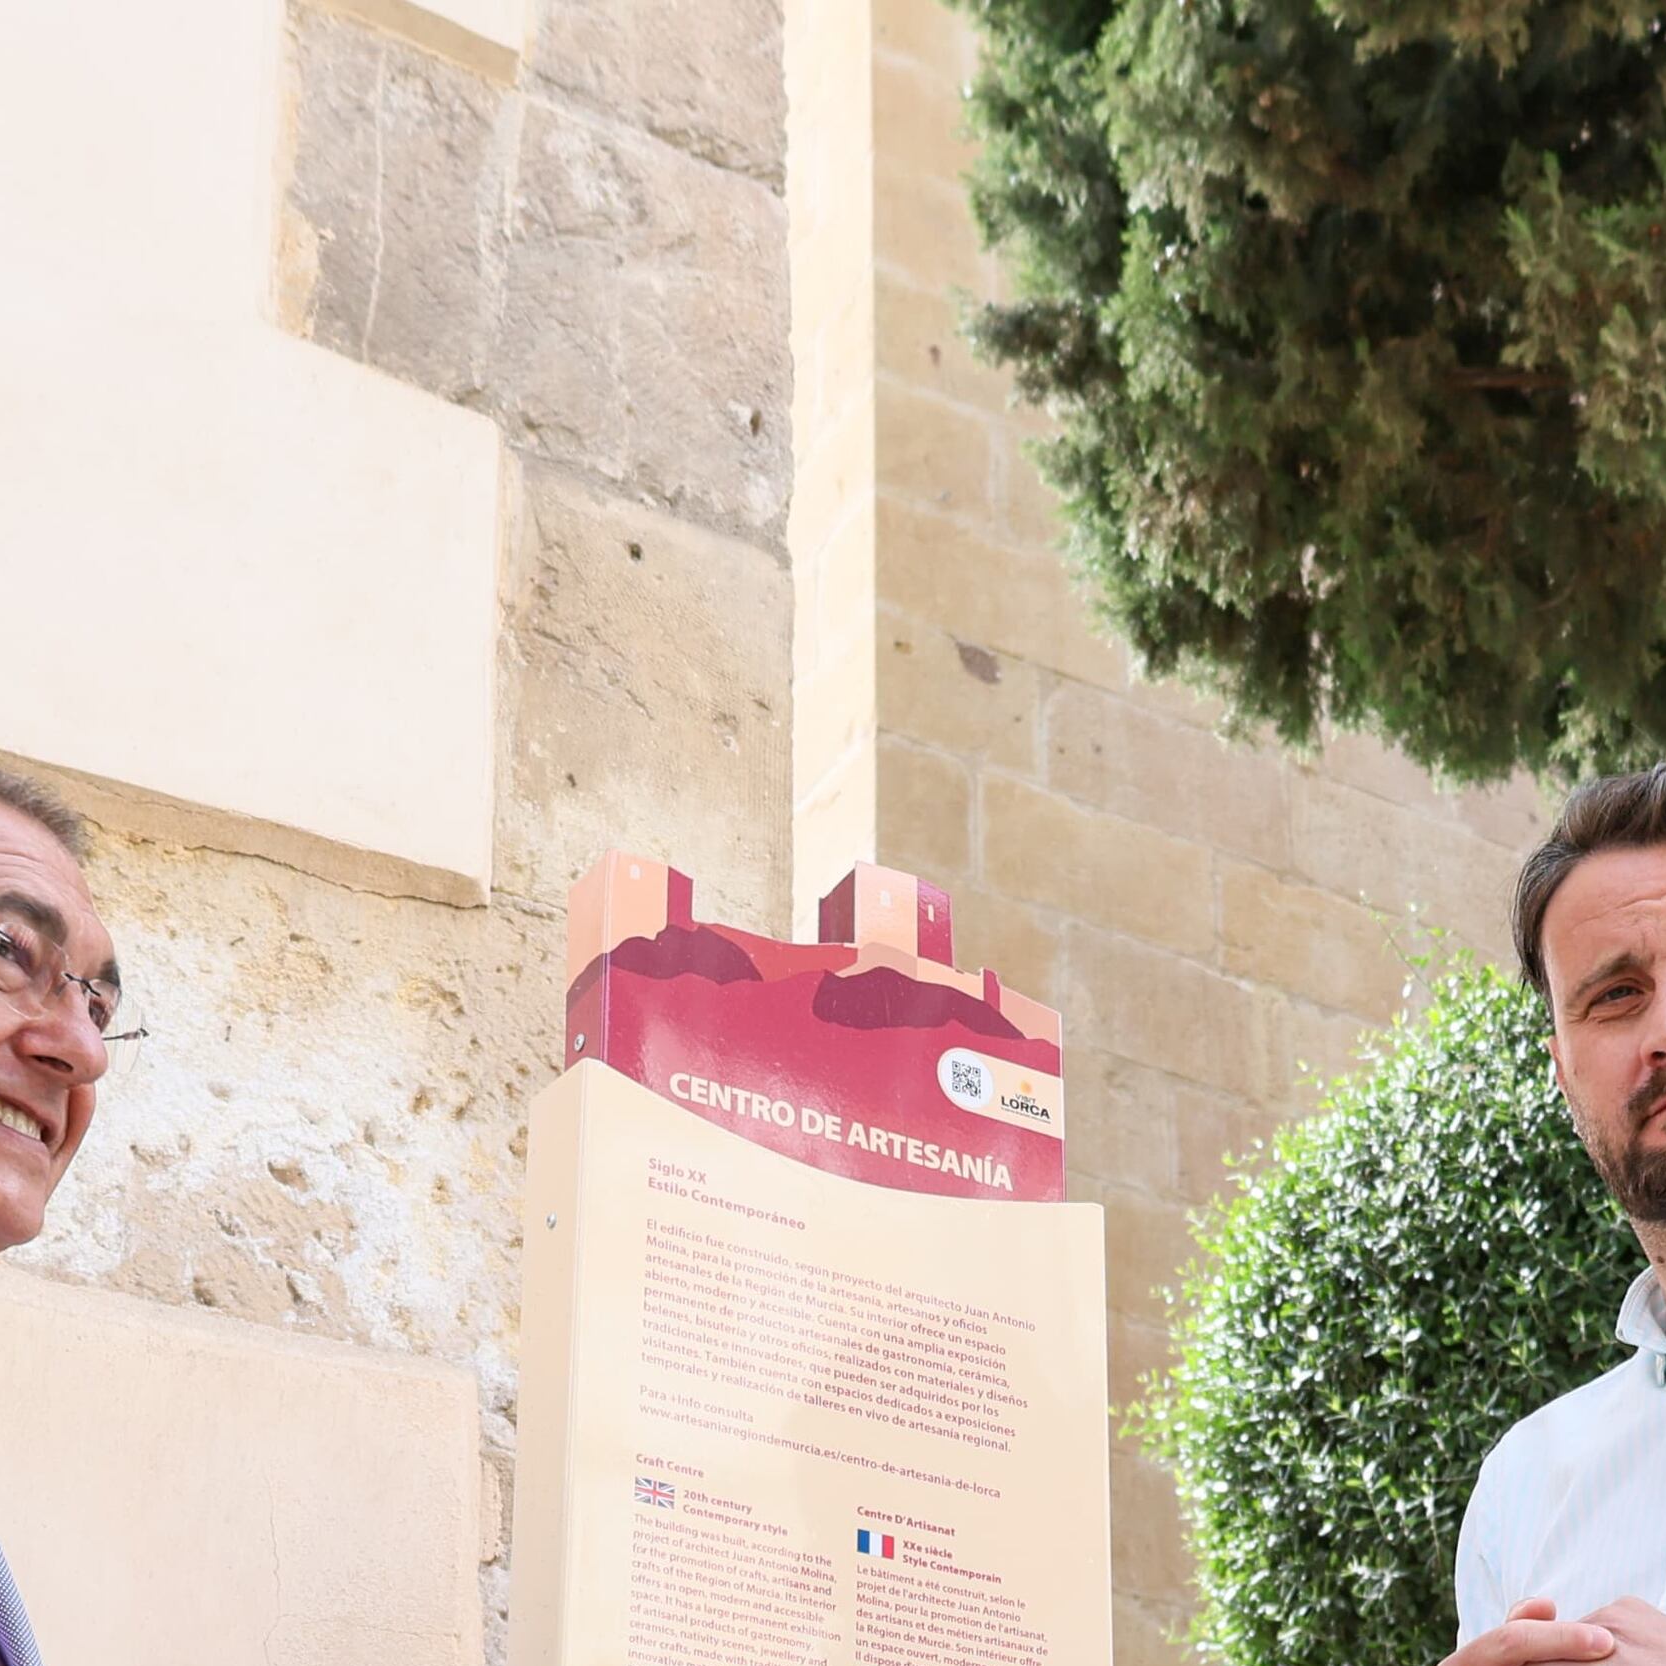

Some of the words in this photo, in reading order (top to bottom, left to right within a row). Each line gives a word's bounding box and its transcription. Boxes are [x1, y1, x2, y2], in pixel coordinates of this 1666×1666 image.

[1001, 1095, 1050, 1119] LORCA
[1015, 1093, 1036, 1104] VISIT
[669, 1072, 795, 1127] CENTRO
[801, 1108, 842, 1143] DE
[847, 1121, 1014, 1192] ARTESANÍA
[857, 1505, 892, 1521] Centre
[894, 1514, 954, 1536] D'Artisanat
[903, 1539, 922, 1552] XXe
[924, 1545, 951, 1558] siècle
[903, 1553, 927, 1567] Style
[929, 1559, 1000, 1583] Contemporain
[856, 1580, 885, 1593] projet
[888, 1584, 900, 1596] de
[902, 1587, 955, 1608] l'architecte
[958, 1600, 980, 1613] Juan
[982, 1605, 1019, 1622] Antonio
[857, 1563, 868, 1574] Le
[870, 1566, 914, 1585] bâtiment
[917, 1579, 922, 1587] a
[925, 1578, 939, 1590] été
[989, 1595, 1014, 1607] selon
[1016, 1599, 1024, 1609] le
[856, 1606, 872, 1619] des
[875, 1613, 913, 1627] artisans
[915, 1621, 924, 1630] et
[927, 1621, 944, 1634] des
[946, 1628, 982, 1642] métiers
[984, 1636, 1033, 1653] artisanaux
[1036, 1645, 1047, 1656] de
[855, 1650, 861, 1659] Il
